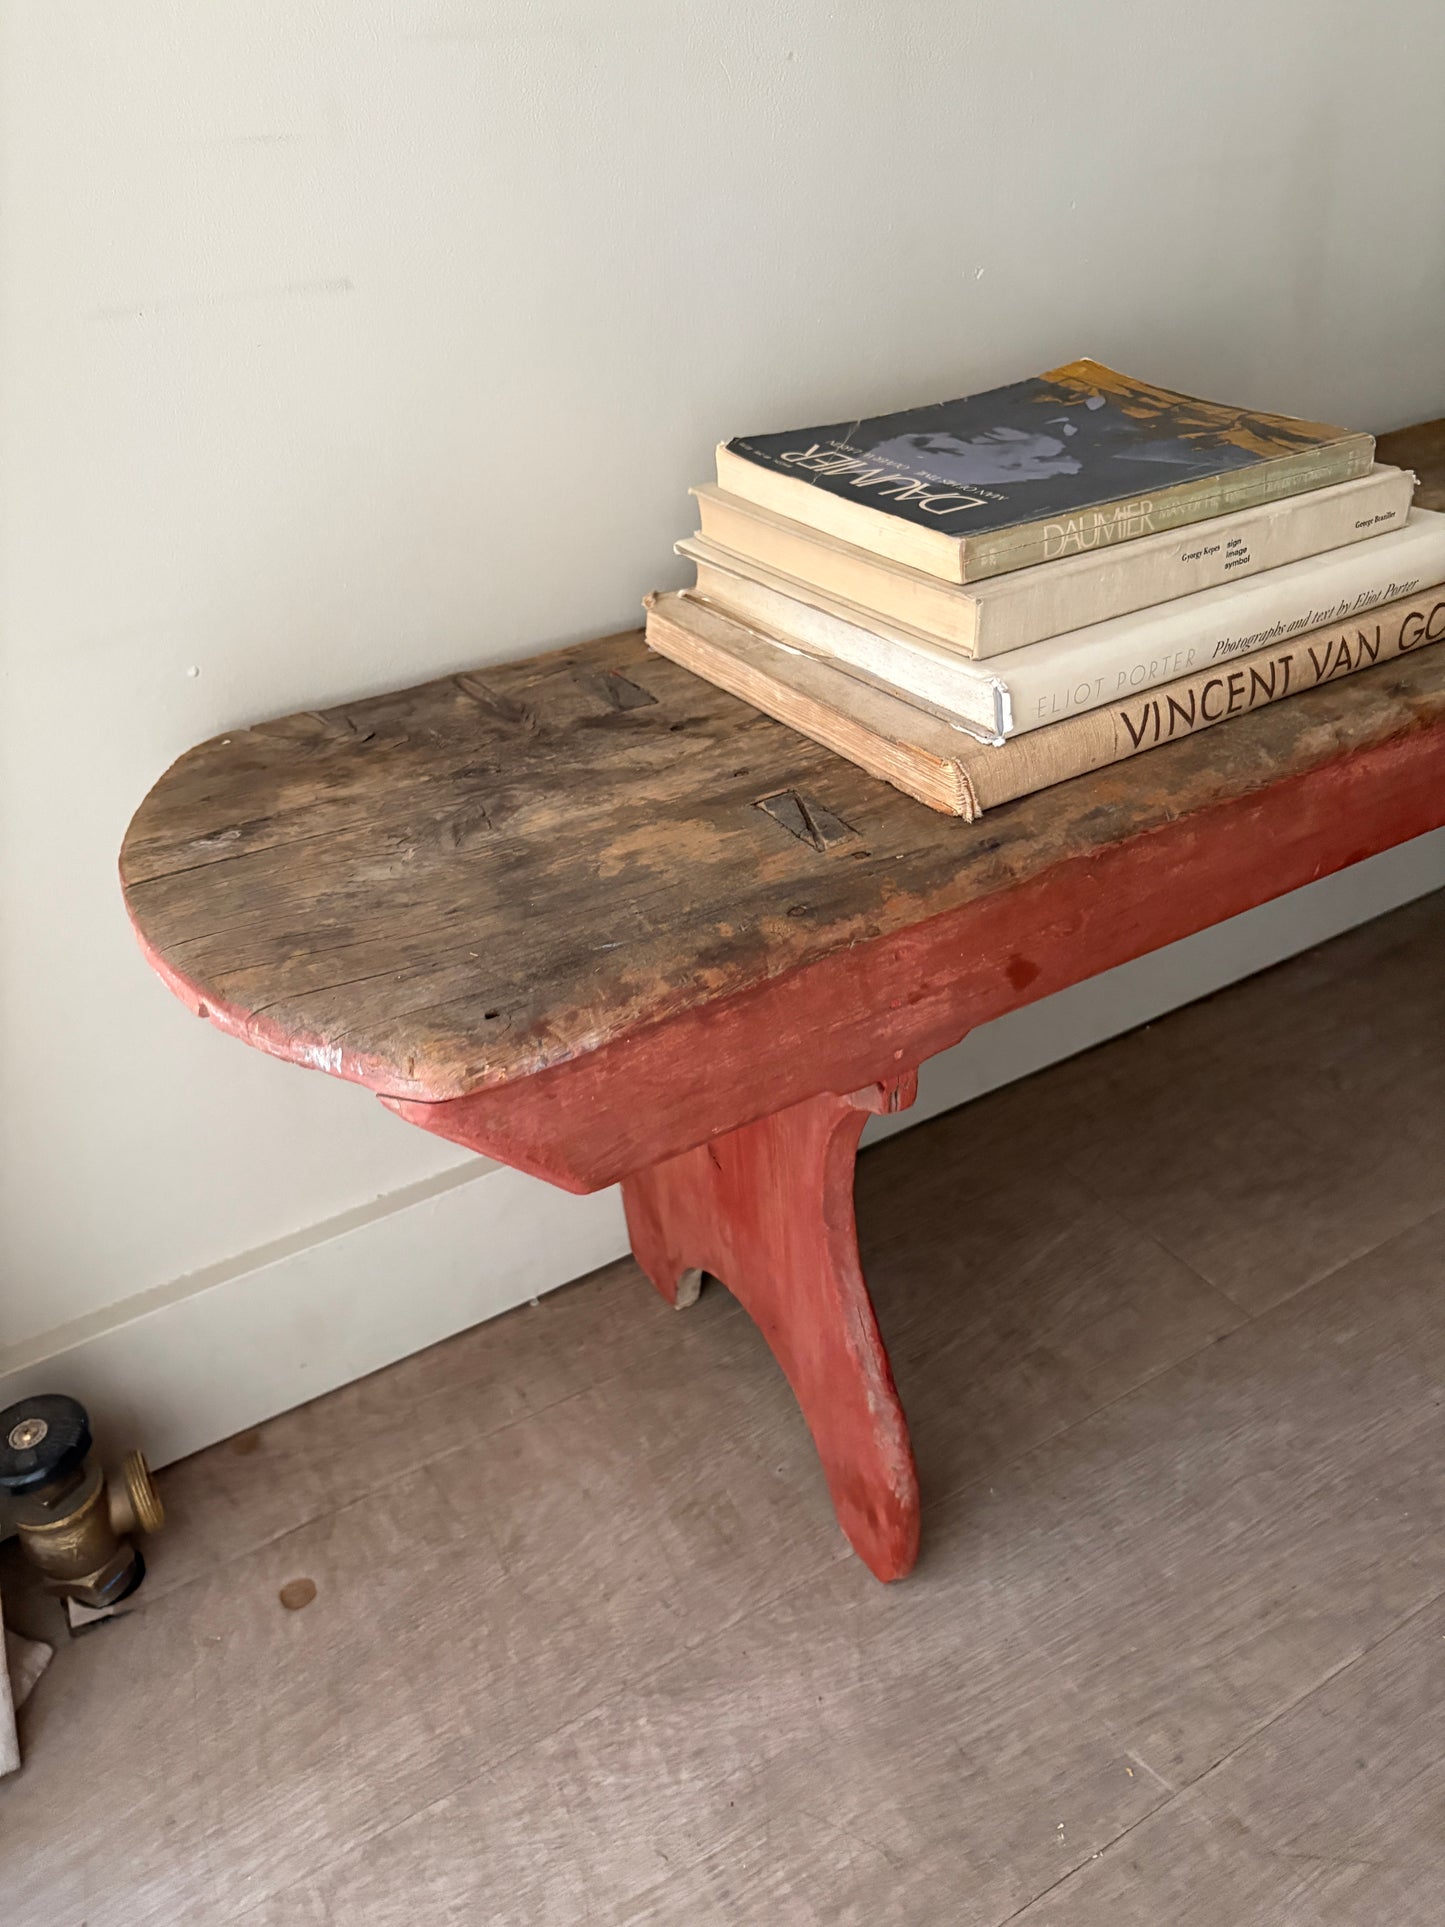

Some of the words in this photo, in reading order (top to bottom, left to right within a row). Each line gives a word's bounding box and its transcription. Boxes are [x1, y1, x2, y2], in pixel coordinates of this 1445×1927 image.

[780, 443, 988, 515] DAUMIER
[1043, 500, 1155, 559] DAUMIER
[1355, 517, 1373, 529] George
[1203, 544, 1221, 556] Kepes
[1225, 546, 1248, 559] image
[1226, 537, 1242, 549] sign
[1224, 555, 1250, 570] symbol
[1212, 620, 1286, 659] Photographs
[1287, 610, 1312, 633] and
[1311, 606, 1335, 625] text
[1337, 599, 1352, 615] by
[1352, 589, 1382, 610] Eliot
[1383, 577, 1420, 600] Porter
[1037, 677, 1105, 719] ELIOT
[1117, 648, 1196, 691] PORTER
[1120, 655, 1293, 749] VINCENT
[1308, 625, 1381, 682] VAN
